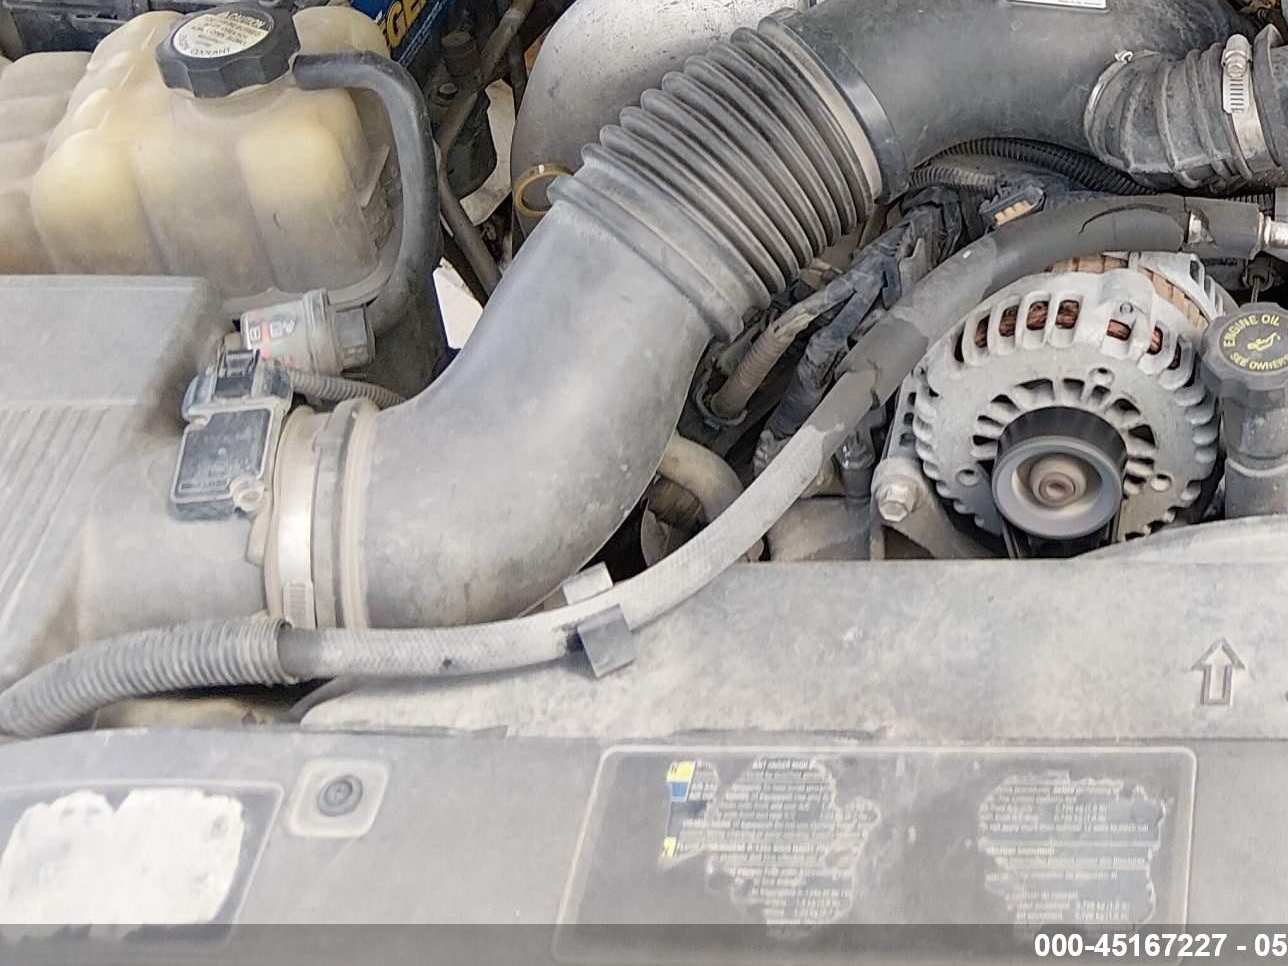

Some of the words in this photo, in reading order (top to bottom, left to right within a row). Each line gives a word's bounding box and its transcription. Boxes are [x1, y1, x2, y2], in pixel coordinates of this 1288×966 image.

[1224, 315, 1259, 347] ENGINE
[1261, 314, 1281, 326] OIL
[1230, 352, 1249, 368] SEE
